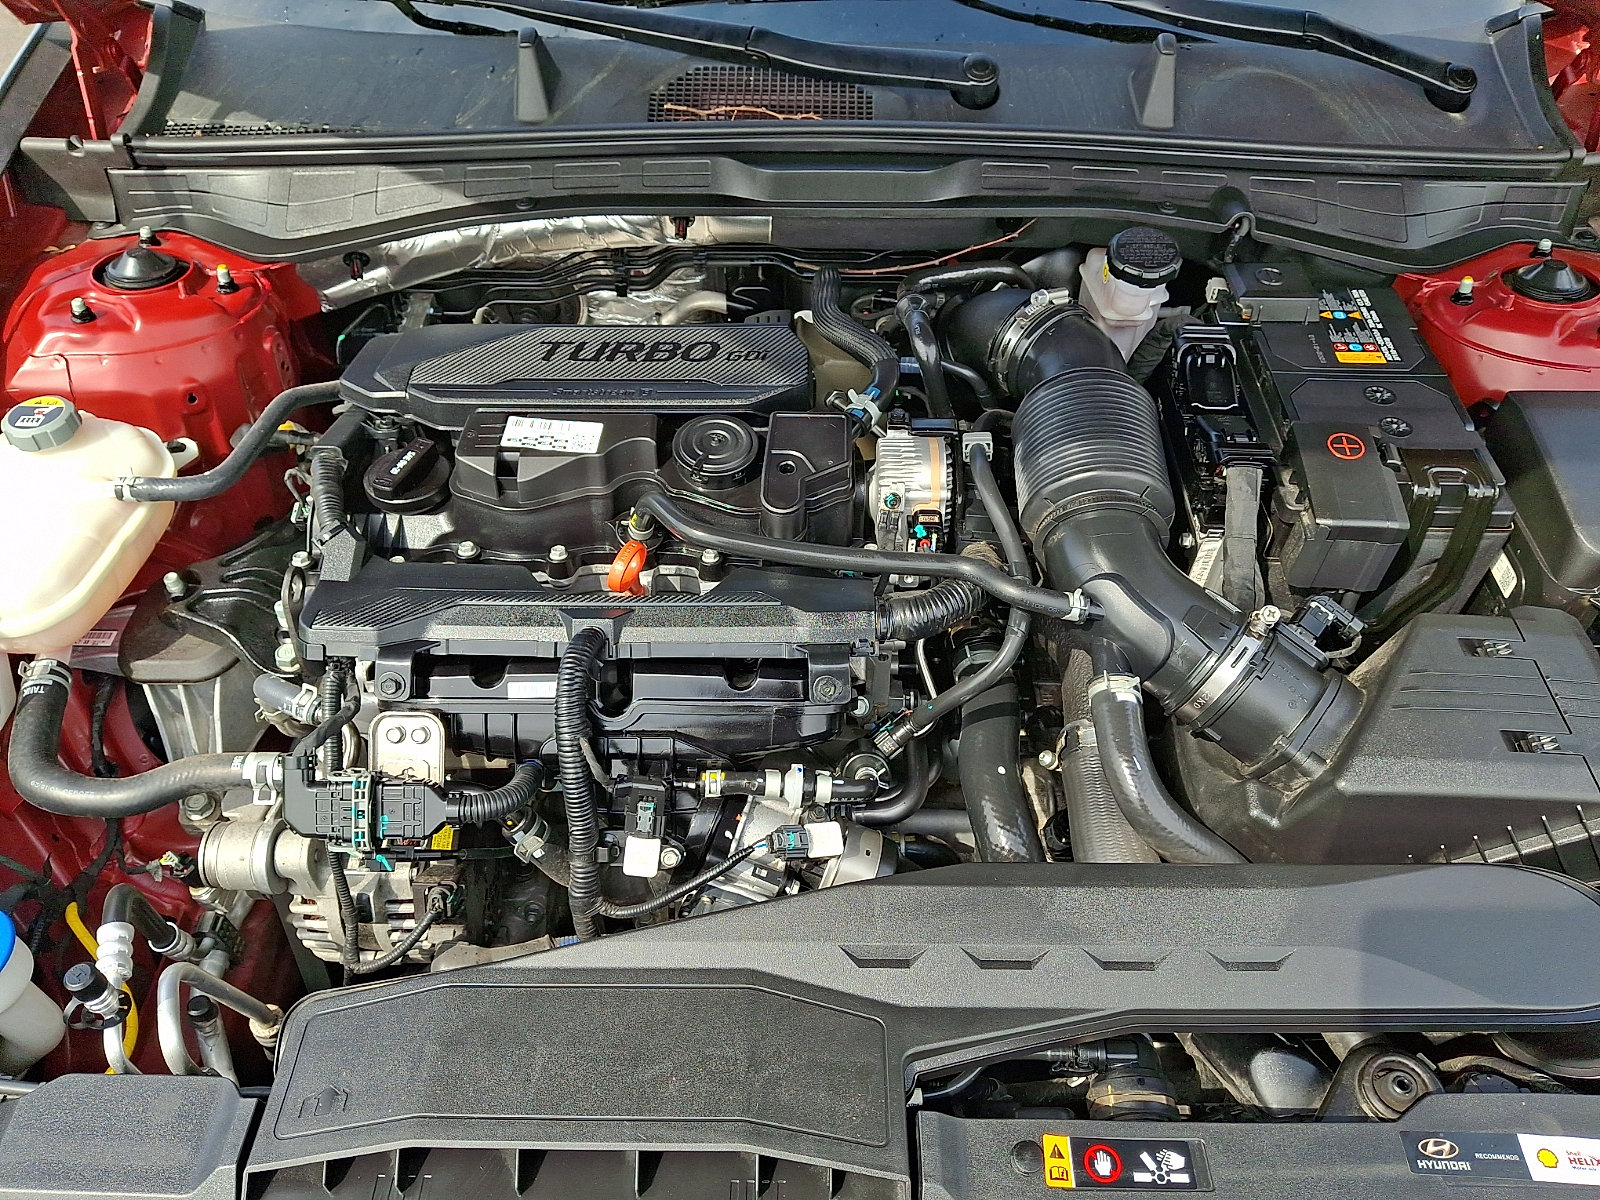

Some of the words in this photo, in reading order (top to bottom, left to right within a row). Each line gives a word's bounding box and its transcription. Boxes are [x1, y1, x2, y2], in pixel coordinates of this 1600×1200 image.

[540, 341, 721, 363] TURBO
[22, 685, 45, 698] TANK
[1417, 1159, 1472, 1171] HYUNDAI
[1474, 1152, 1520, 1161] RECOMMENDS
